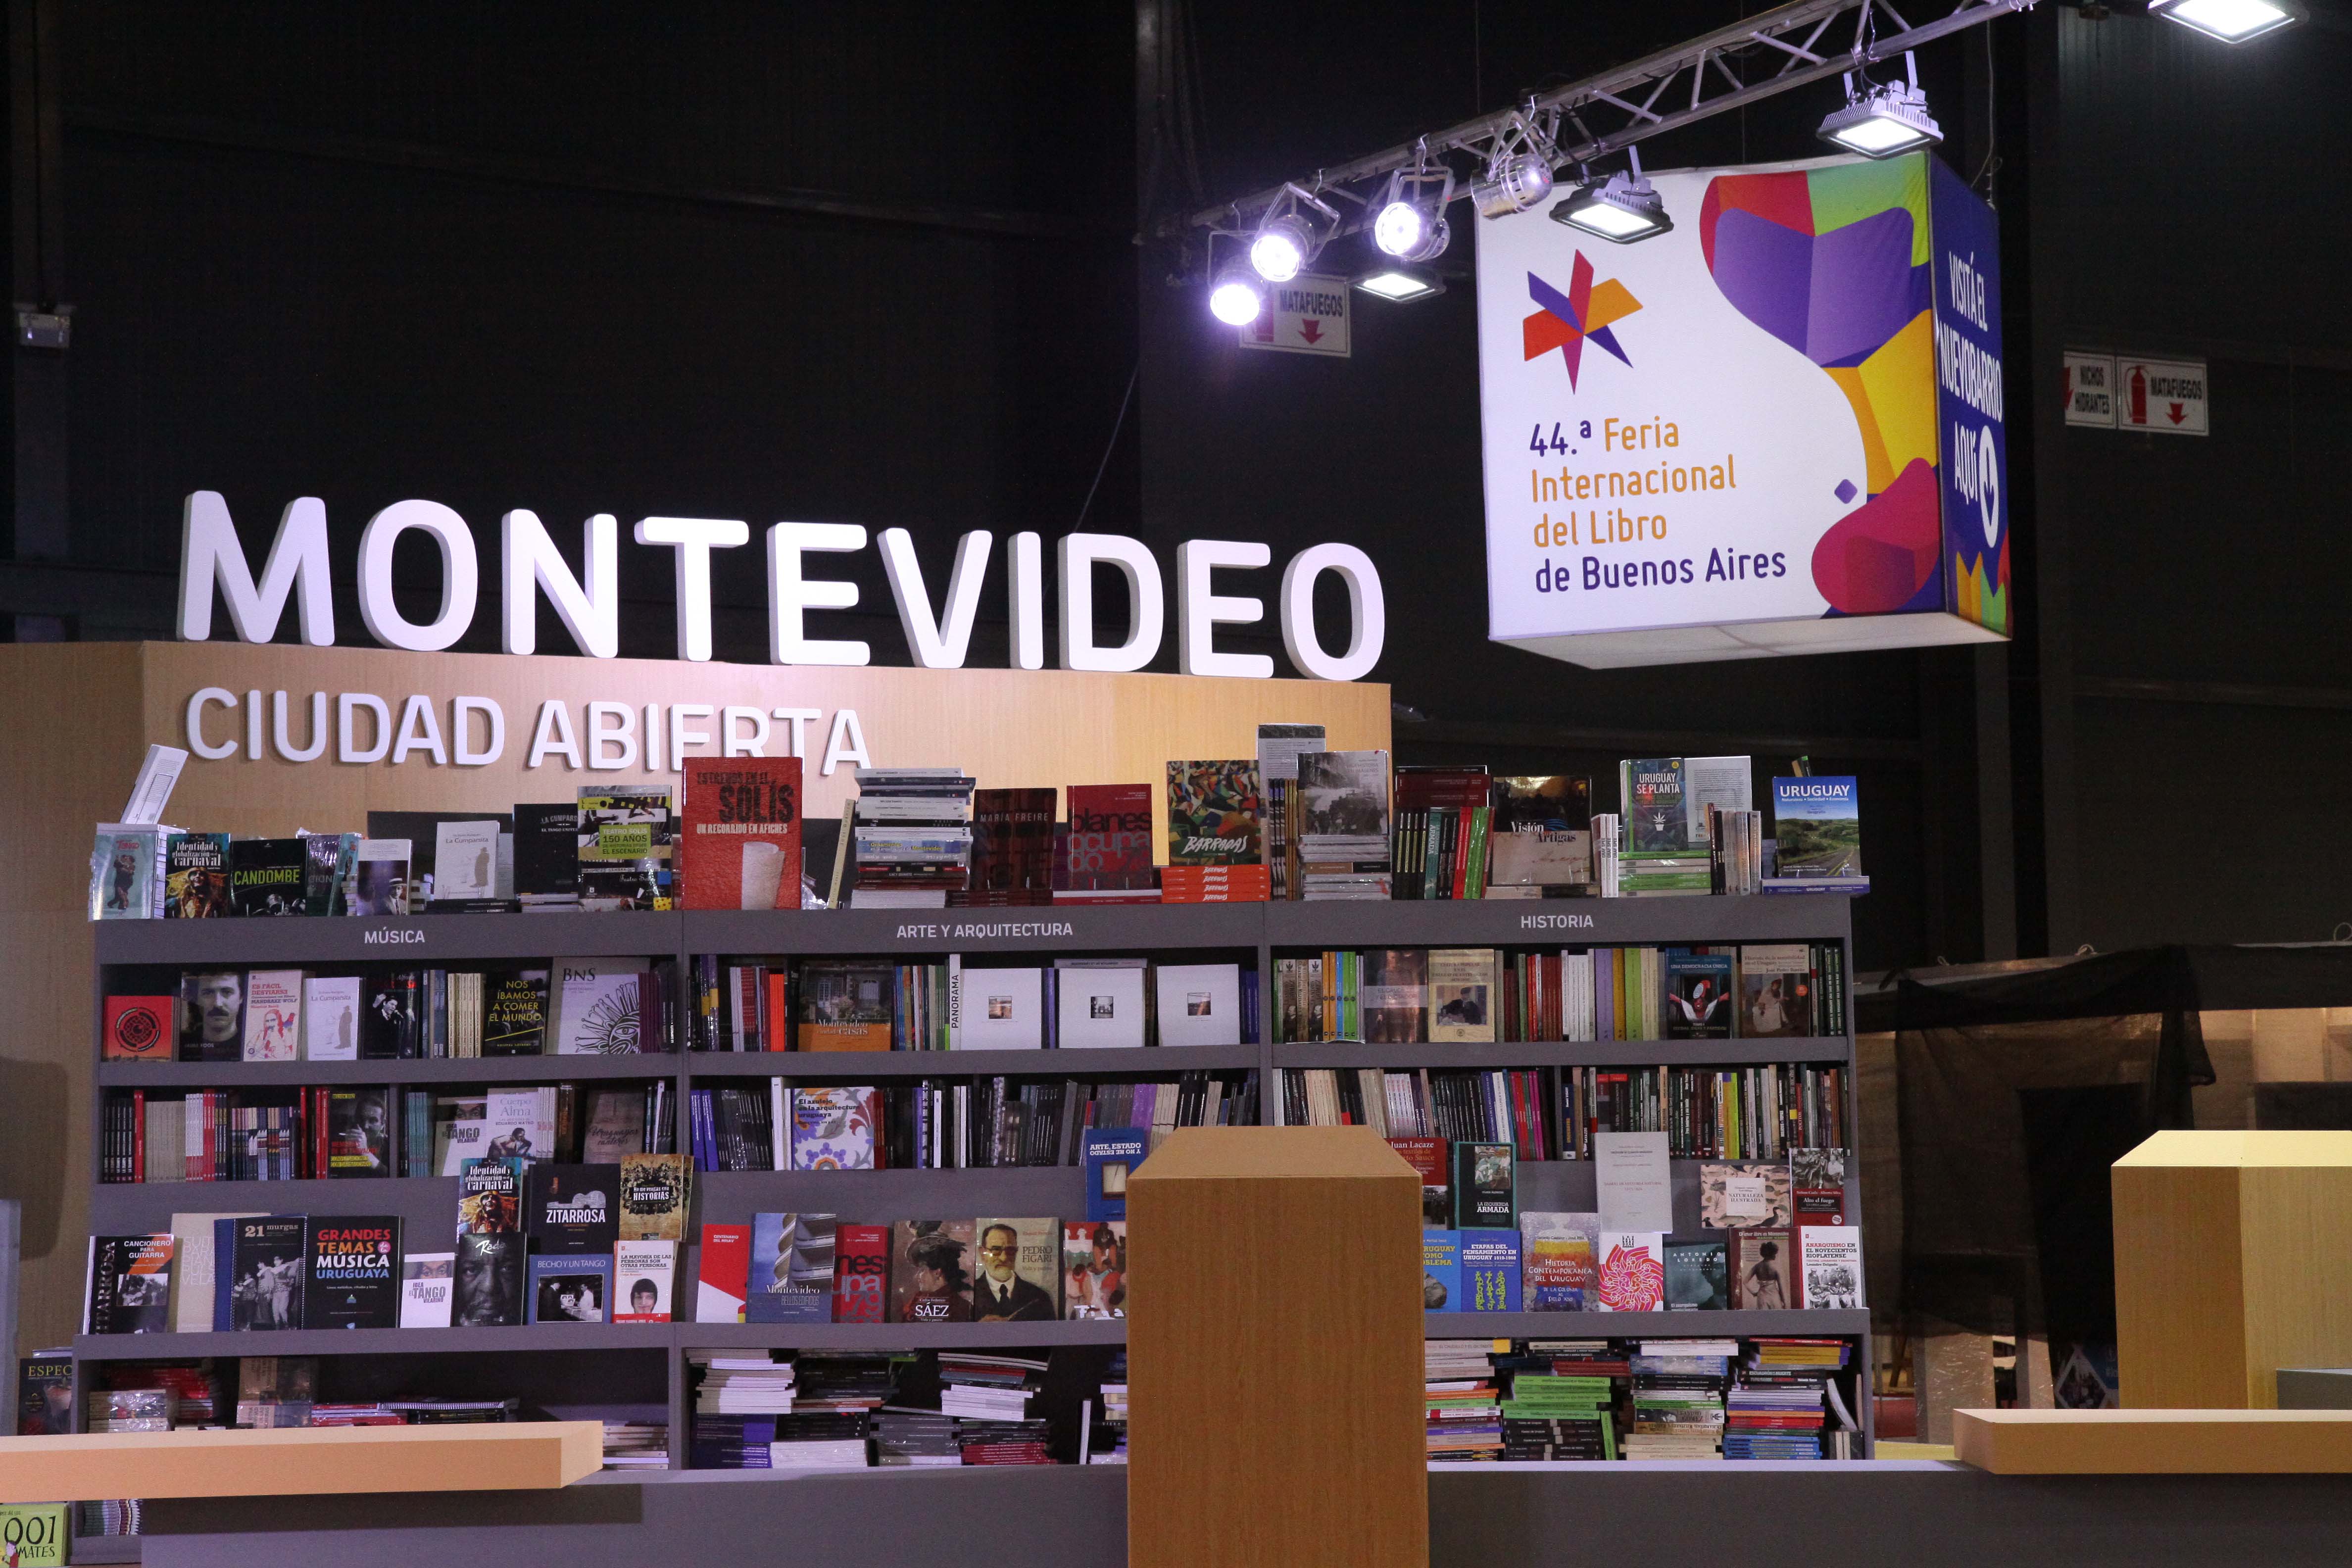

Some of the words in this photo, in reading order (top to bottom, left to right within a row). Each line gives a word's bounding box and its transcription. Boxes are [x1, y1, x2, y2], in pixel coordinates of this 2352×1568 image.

[1949, 250, 1977, 325] VISITÁ
[1977, 273, 1988, 332] EL
[1279, 290, 1343, 317] MATAFUEGOS
[2151, 377, 2202, 400] MATAFUEGOS
[1604, 416, 1679, 452] Feria
[1531, 454, 1737, 503] Internacional
[1533, 513, 1579, 548] del
[1589, 507, 1668, 544] Libro
[1535, 557, 1570, 593] de
[1582, 548, 1694, 588] Buenos
[1705, 548, 1787, 582] Aires
[177, 490, 1385, 681] MONTEVIDEO
[186, 687, 505, 765] CIUDAD
[527, 699, 872, 776] ABIERTA
[1639, 773, 1676, 783] URUGUAY
[1637, 784, 1648, 794] SE
[1649, 783, 1680, 794] PLANTA
[1780, 785, 1850, 797] URUGUAY
[719, 778, 794, 824] SOLÍS
[980, 812, 1010, 822] MARÍA
[1015, 811, 1049, 822] FREIRE
[697, 824, 704, 833] UN
[705, 823, 747, 834] RECORRIDO
[748, 823, 758, 833] EN
[759, 823, 788, 833] AFICHES
[1511, 821, 1545, 833] Visión
[176, 841, 213, 852] Identidad
[174, 854, 221, 867] carnaval
[234, 869, 300, 885] CANDOMBE
[1520, 915, 1594, 929] HISTORIA
[364, 927, 426, 944] MÚSICA
[896, 925, 936, 938] ARTE
[940, 925, 951, 937] Y
[954, 923, 1073, 939] ARQUITECTURA
[506, 980, 528, 989] NOS
[497, 990, 536, 1000] ÍBAMOS
[951, 974, 960, 1029] PANORAMA
[503, 1002, 539, 1011] COMER
[489, 1013, 499, 1022] EL
[502, 1012, 542, 1022] MUNDO
[470, 1165, 506, 1176] Identidad
[467, 1178, 513, 1191] carnaval
[633, 1191, 669, 1201] HISTORIAS
[545, 1209, 606, 1224] ZITARROSA
[245, 1225, 264, 1238] 21
[266, 1222, 299, 1232] murgas
[317, 1228, 391, 1242] GRANDES
[124, 1239, 171, 1248] CANCIONERO
[317, 1241, 374, 1255] TEMAS
[1022, 1246, 1053, 1255] PEDRO
[317, 1252, 390, 1269] MÚSICA
[538, 1260, 561, 1269] BECHO
[580, 1259, 606, 1268] TANGO
[1022, 1254, 1052, 1263] FIGARI
[316, 1269, 390, 1280] URUGUAYA
[413, 1286, 446, 1299] TANGO
[766, 1284, 820, 1295] Montevideo
[915, 1302, 949, 1317] SÁEZ
